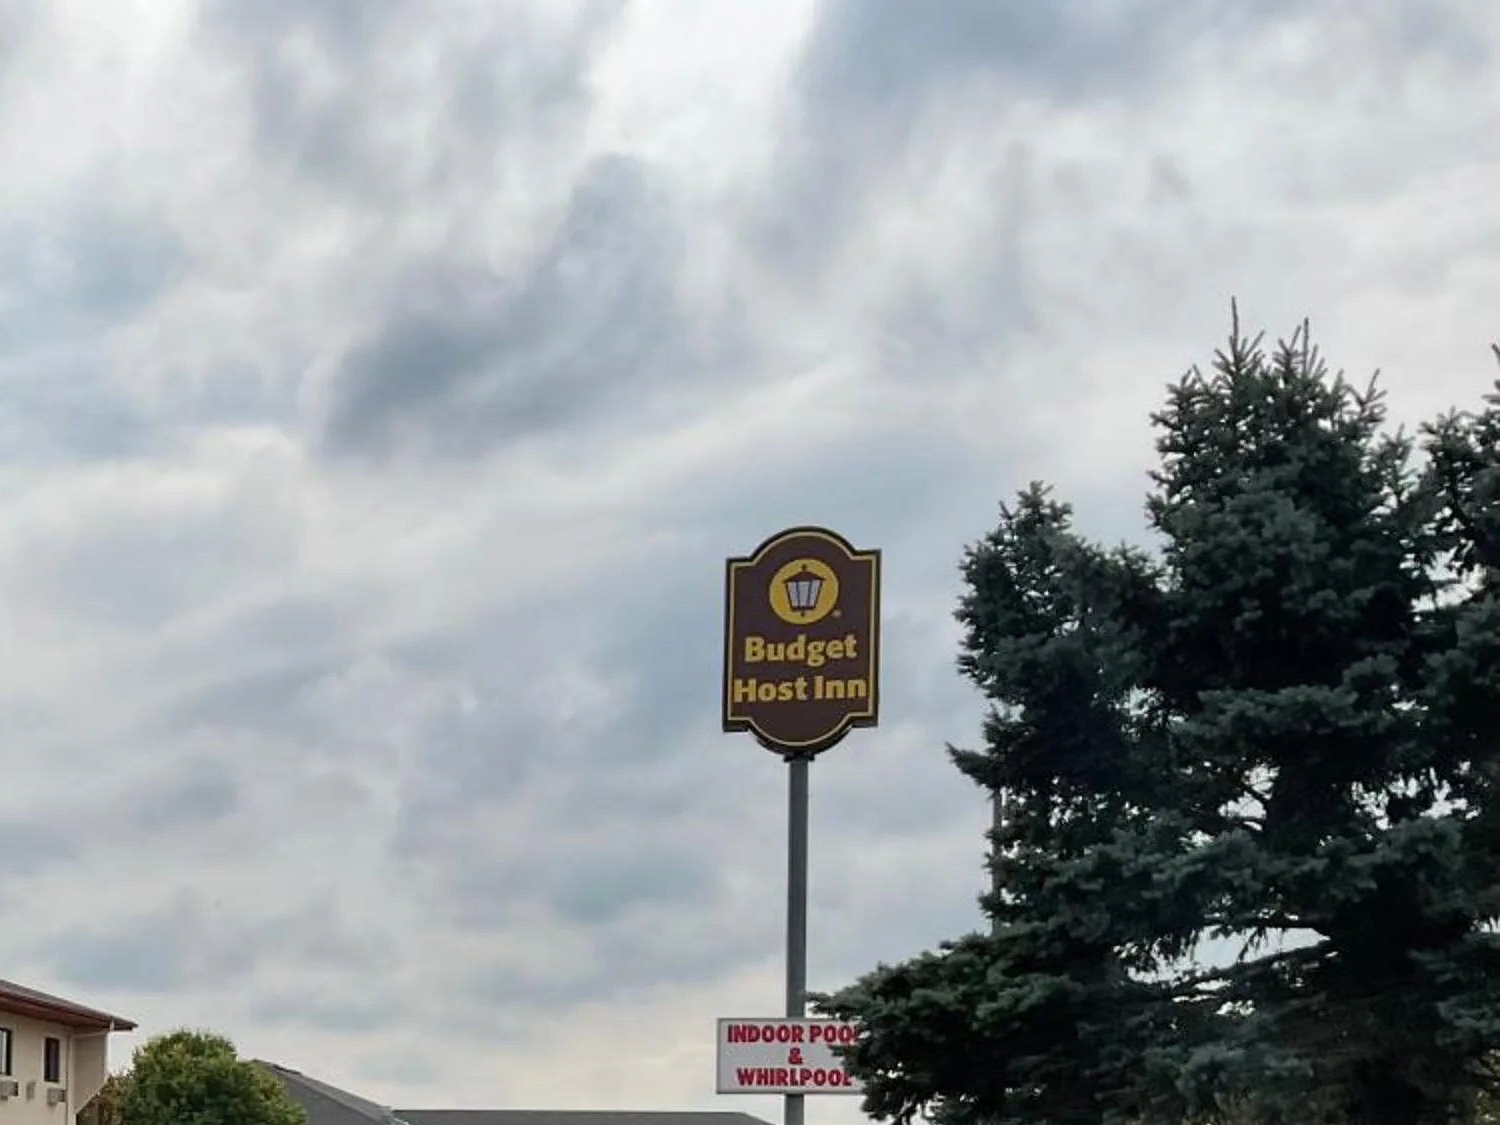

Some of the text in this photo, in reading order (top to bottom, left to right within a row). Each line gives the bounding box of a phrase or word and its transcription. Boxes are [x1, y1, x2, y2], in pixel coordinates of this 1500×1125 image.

[744, 634, 857, 667] Budget
[734, 675, 868, 702] Host Inn
[726, 1024, 805, 1043] INDOOR
[787, 1047, 803, 1065] &
[736, 1067, 853, 1087] WHIRLPOOL
